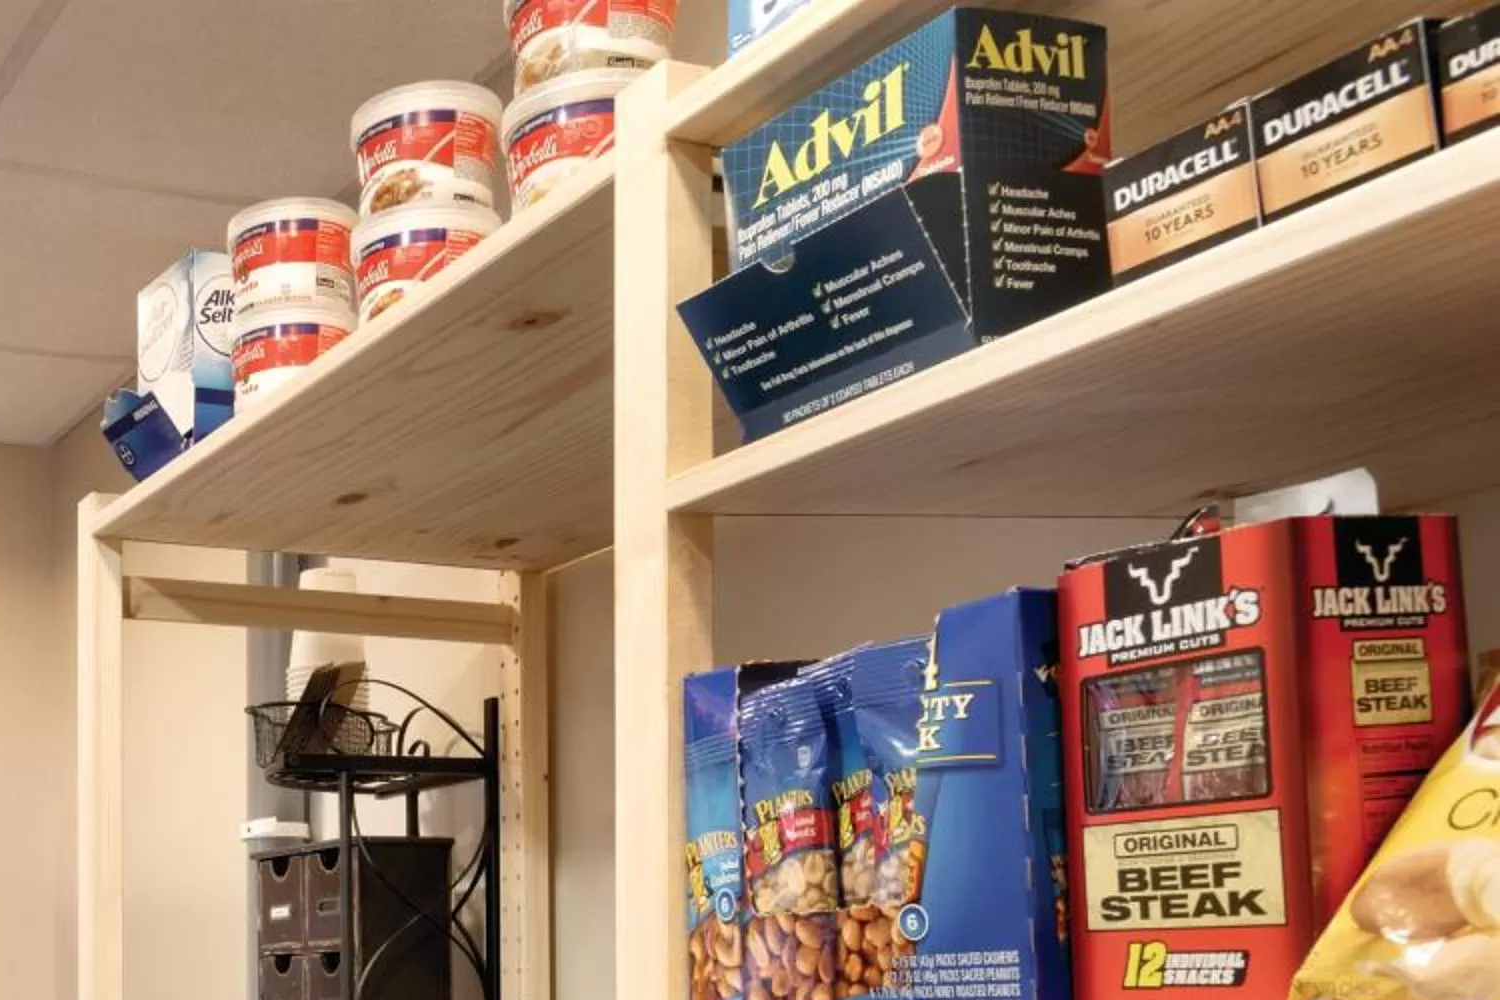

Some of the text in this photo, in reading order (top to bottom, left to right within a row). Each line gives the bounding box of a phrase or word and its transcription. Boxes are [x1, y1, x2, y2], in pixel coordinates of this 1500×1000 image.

[967, 23, 1088, 80] Advil
[1263, 61, 1411, 146] DURACELL
[753, 65, 904, 208] Advil
[1302, 133, 1383, 178] 10 YEARS
[1113, 140, 1239, 211] DURACELL
[1145, 204, 1215, 244] 10 YEARS
[1007, 278, 1034, 289] Fever
[1313, 582, 1446, 617] JACK LINK'S
[1079, 590, 1260, 657] JACK LINK'S
[1111, 634, 1221, 663] PREMIUM CUTS
[1358, 642, 1419, 657] ORIGINAL
[1365, 677, 1418, 694] BEEF
[1357, 695, 1428, 713] STEAK
[1124, 831, 1226, 853] ORIGINAL
[1118, 862, 1242, 893] BEEF
[1100, 889, 1268, 922] STEAK
[1124, 941, 1167, 988] 12
[1163, 969, 1235, 985] SNACKS
